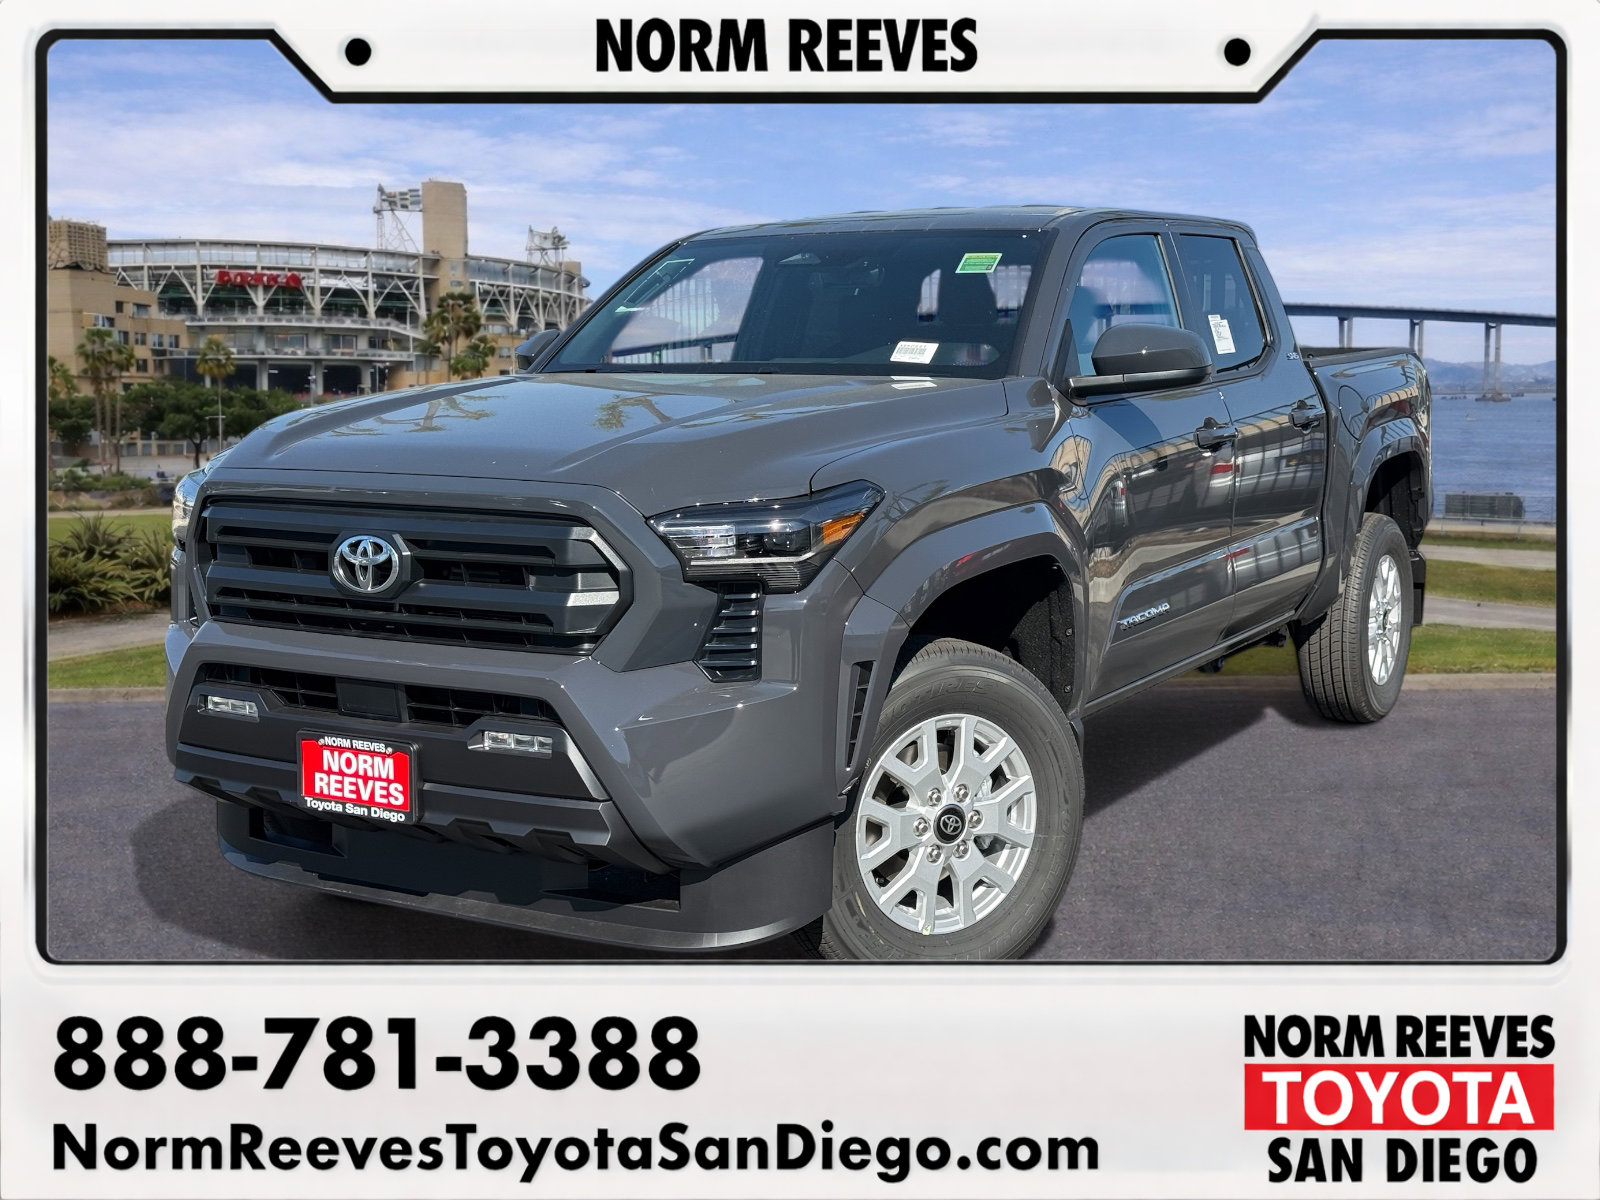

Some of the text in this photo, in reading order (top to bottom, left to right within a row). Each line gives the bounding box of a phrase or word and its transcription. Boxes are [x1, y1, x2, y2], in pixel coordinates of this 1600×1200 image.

[1117, 602, 1170, 629] TACOMA
[324, 736, 386, 753] NORM REEVES
[322, 749, 395, 780] NORM
[314, 771, 405, 806] REEVES
[304, 797, 406, 822] Toyota San Diego
